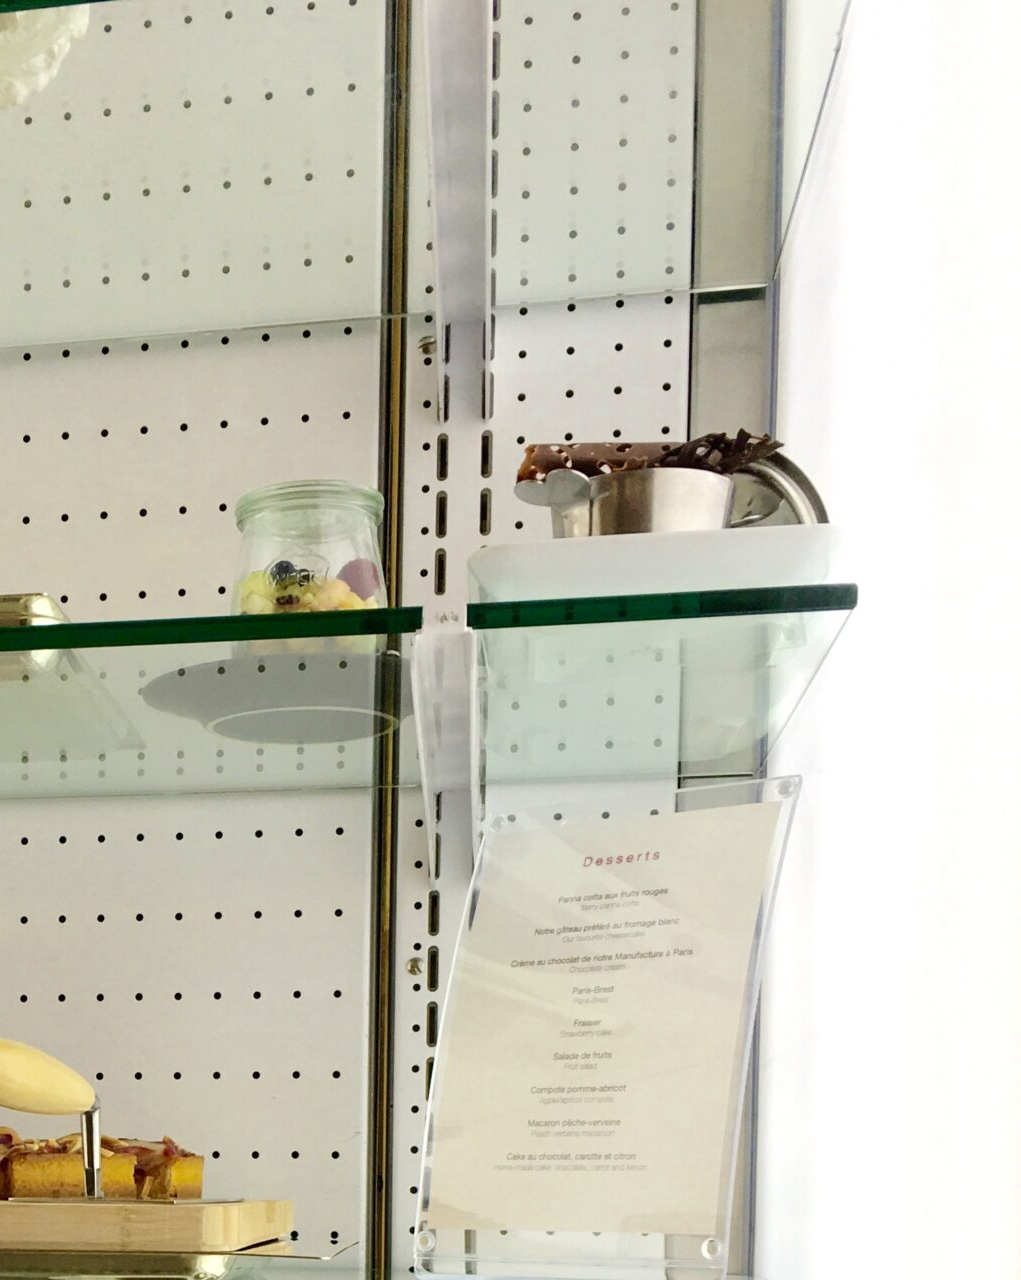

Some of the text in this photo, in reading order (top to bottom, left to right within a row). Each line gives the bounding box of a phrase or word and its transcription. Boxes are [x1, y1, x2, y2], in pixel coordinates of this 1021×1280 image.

[582, 850, 660, 867] Desserts
[558, 895, 581, 904] Panna
[583, 893, 602, 902] cotta
[620, 890, 639, 899] fruits
[641, 888, 668, 897] rouges
[534, 928, 554, 936] Notre
[624, 919, 656, 929] fromage
[658, 917, 680, 926] blanc
[547, 955, 579, 965] chocolat
[581, 954, 591, 962] de
[593, 953, 613, 961] notre
[614, 950, 664, 961] Manufacture
[673, 947, 694, 956] Paris
[572, 985, 615, 994] Paris-Brest
[553, 1051, 612, 1061] Salade de fruits
[530, 1084, 626, 1095] Compote pomme-abricot
[527, 1119, 560, 1127] Macaron
[506, 1152, 636, 1161] Cake au chocolat, carotte et citron
